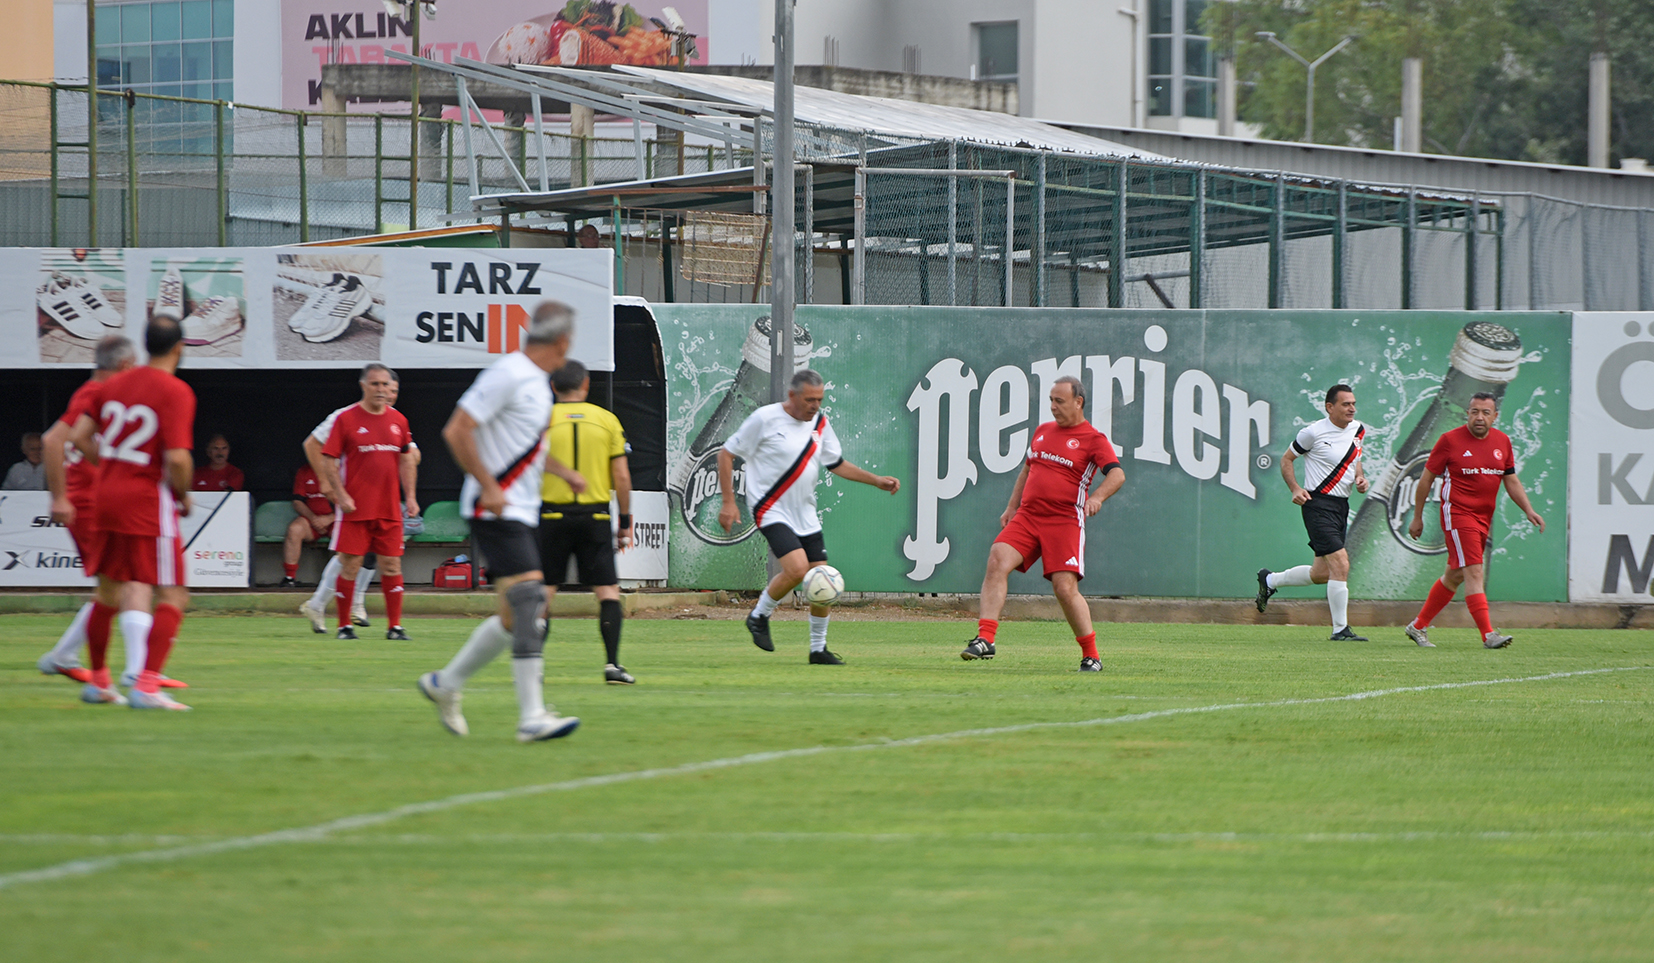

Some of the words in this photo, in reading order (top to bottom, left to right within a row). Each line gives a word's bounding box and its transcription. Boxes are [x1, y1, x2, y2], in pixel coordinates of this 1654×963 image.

[305, 12, 413, 40] AKLIN
[431, 262, 541, 295] TARZ
[99, 400, 160, 466] 22
[1040, 450, 1074, 467] Telekom
[1461, 467, 1480, 475] Türk
[1597, 453, 1654, 505] K
[634, 522, 666, 549] STREET
